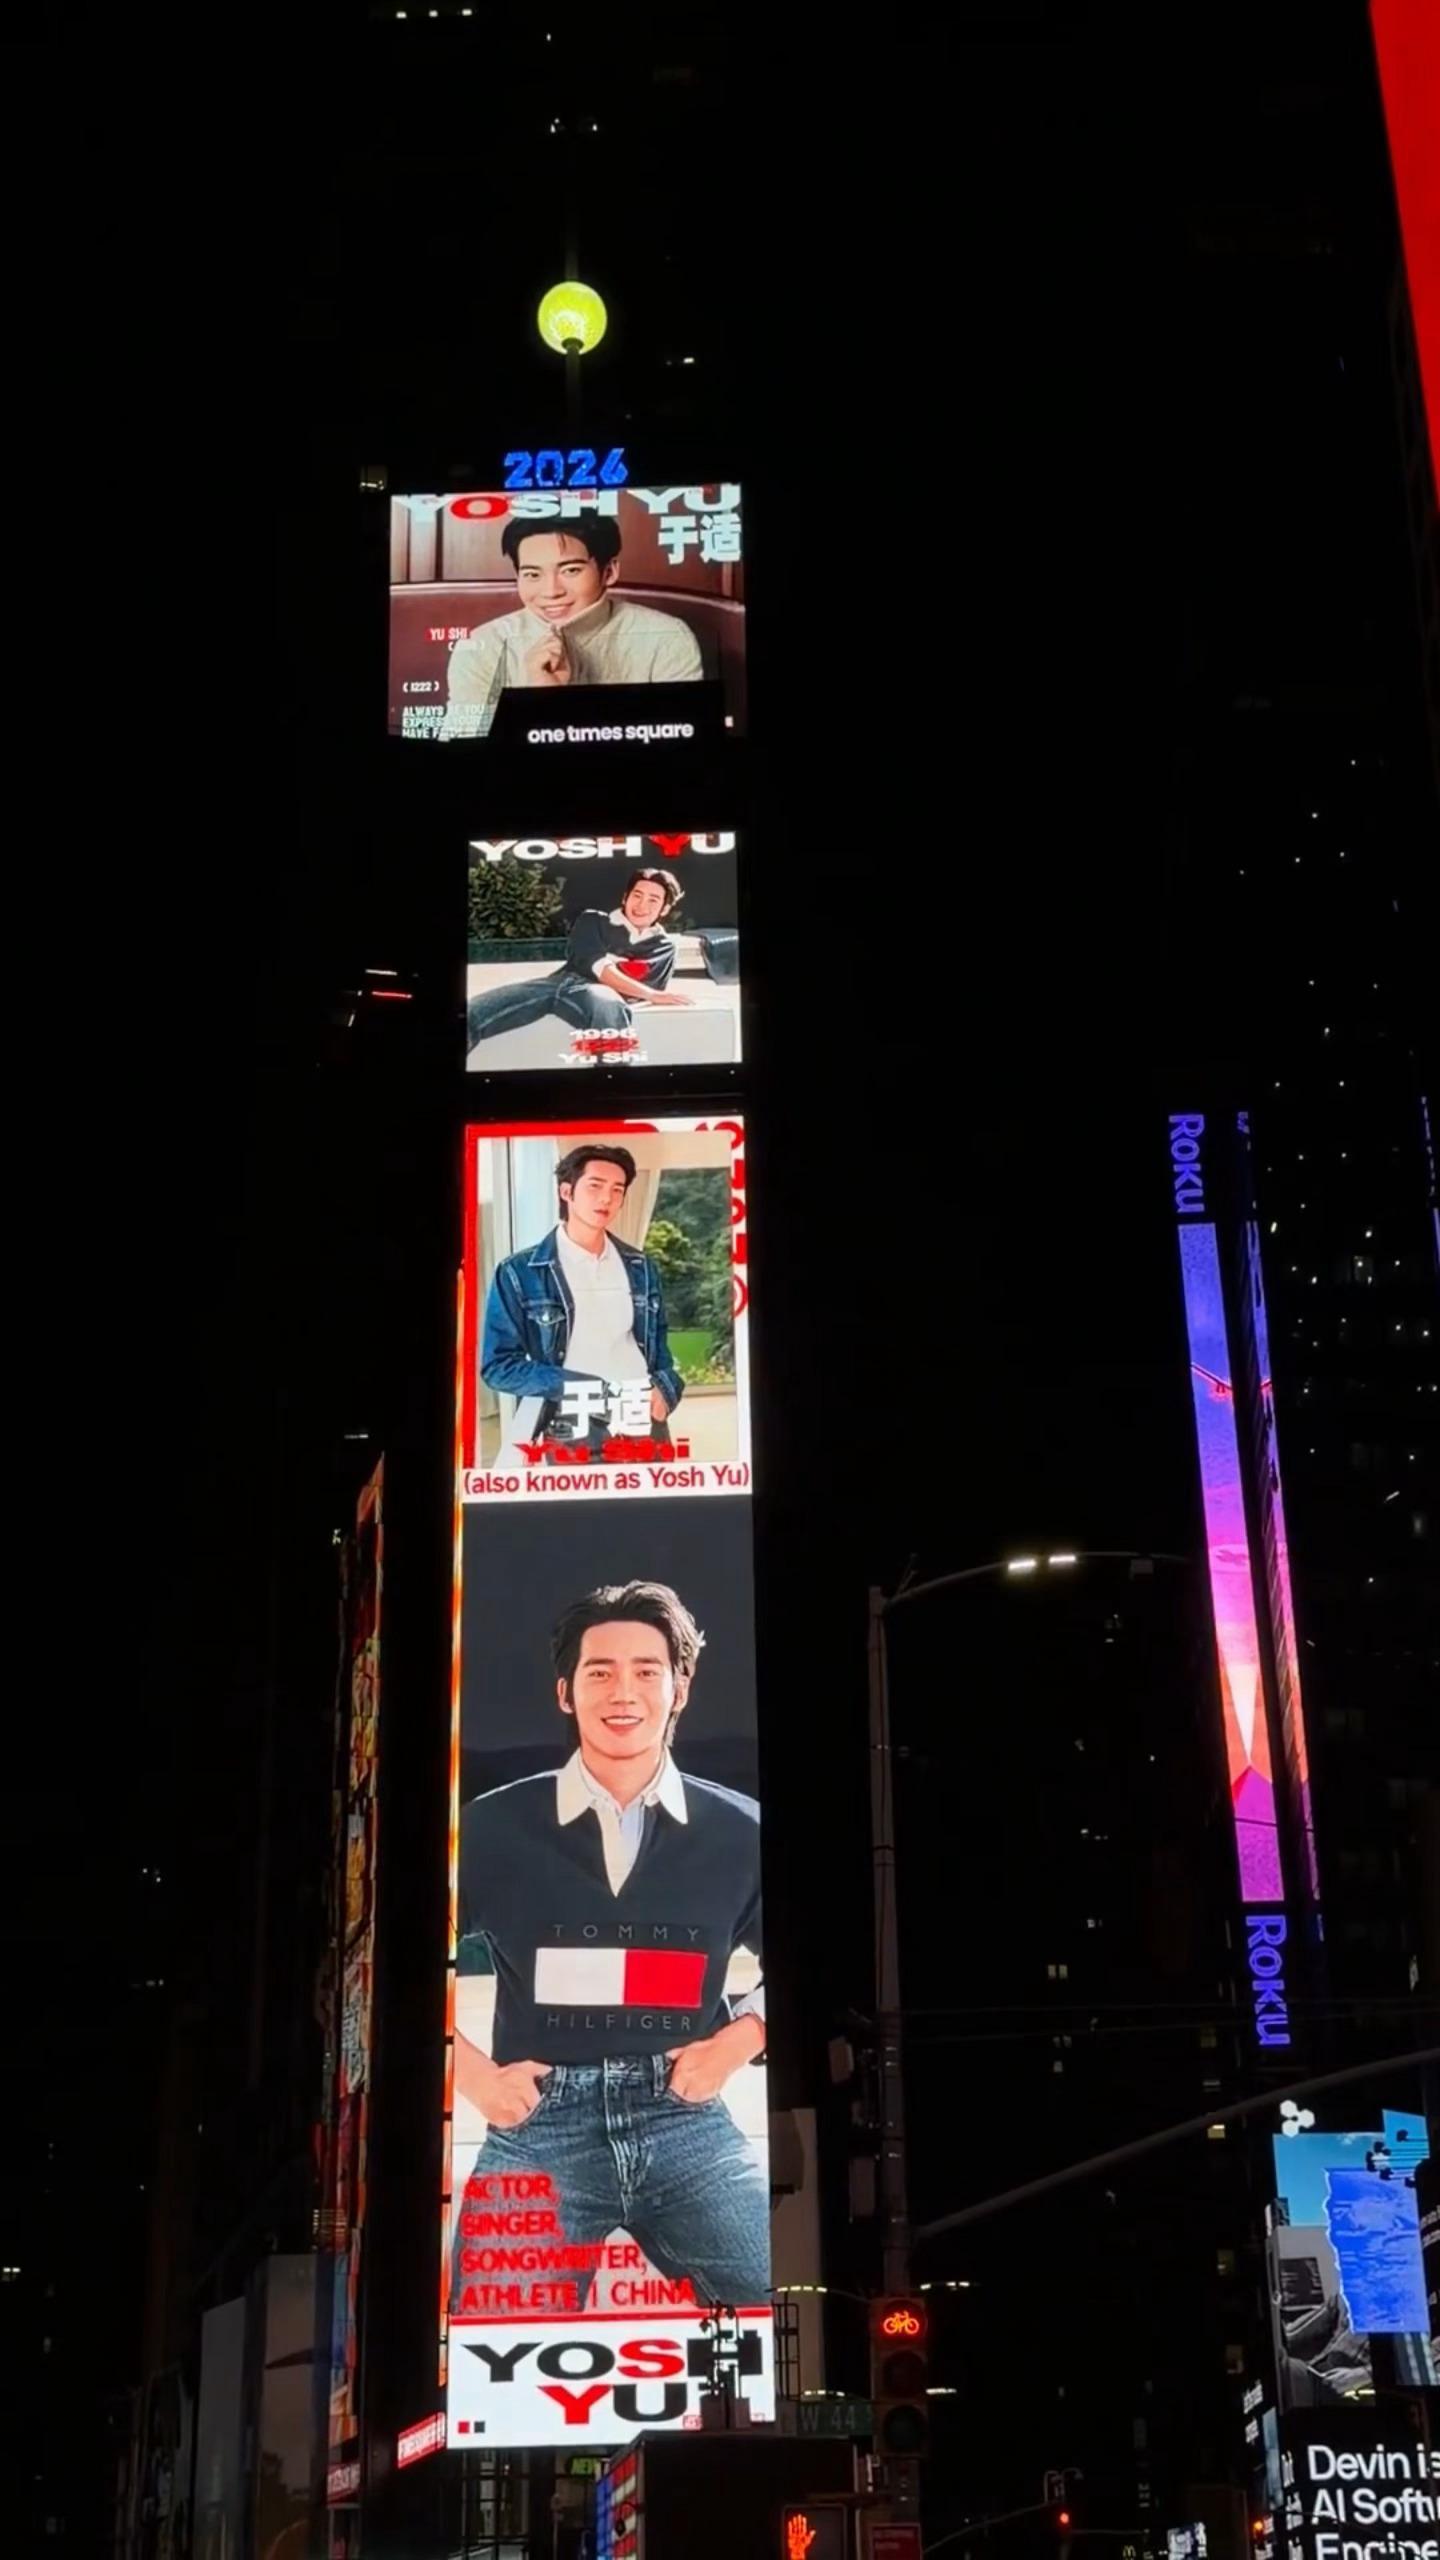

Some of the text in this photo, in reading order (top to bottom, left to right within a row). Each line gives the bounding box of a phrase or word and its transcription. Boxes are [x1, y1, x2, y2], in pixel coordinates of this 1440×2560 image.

[504, 448, 628, 487] 2026
[392, 484, 741, 524] YOSH YU
[658, 513, 742, 565] 于适
[430, 626, 468, 640] YU SHI
[527, 723, 694, 744] one times square
[469, 831, 736, 861] YOSH YU
[557, 1050, 648, 1064] Yu Shi
[560, 1377, 652, 1439] 于适
[512, 1441, 592, 1466] Yu
[464, 1462, 751, 1494] (also known as Yosh Yu)
[553, 1923, 701, 1940] TOMMY
[546, 2014, 692, 2032] HILFIGER
[464, 2173, 560, 2203] ACTOR,
[461, 2211, 563, 2238] SINGER,
[461, 2243, 648, 2274] SONGWRITER,
[461, 2281, 579, 2309] ATHLETE
[610, 2277, 697, 2306] CHINA
[460, 2336, 763, 2382] YOSH
[537, 2382, 688, 2425] YU
[830, 2403, 856, 2431] 44
[1307, 2443, 1411, 2480] Devin
[1311, 2488, 1346, 2524] AI
